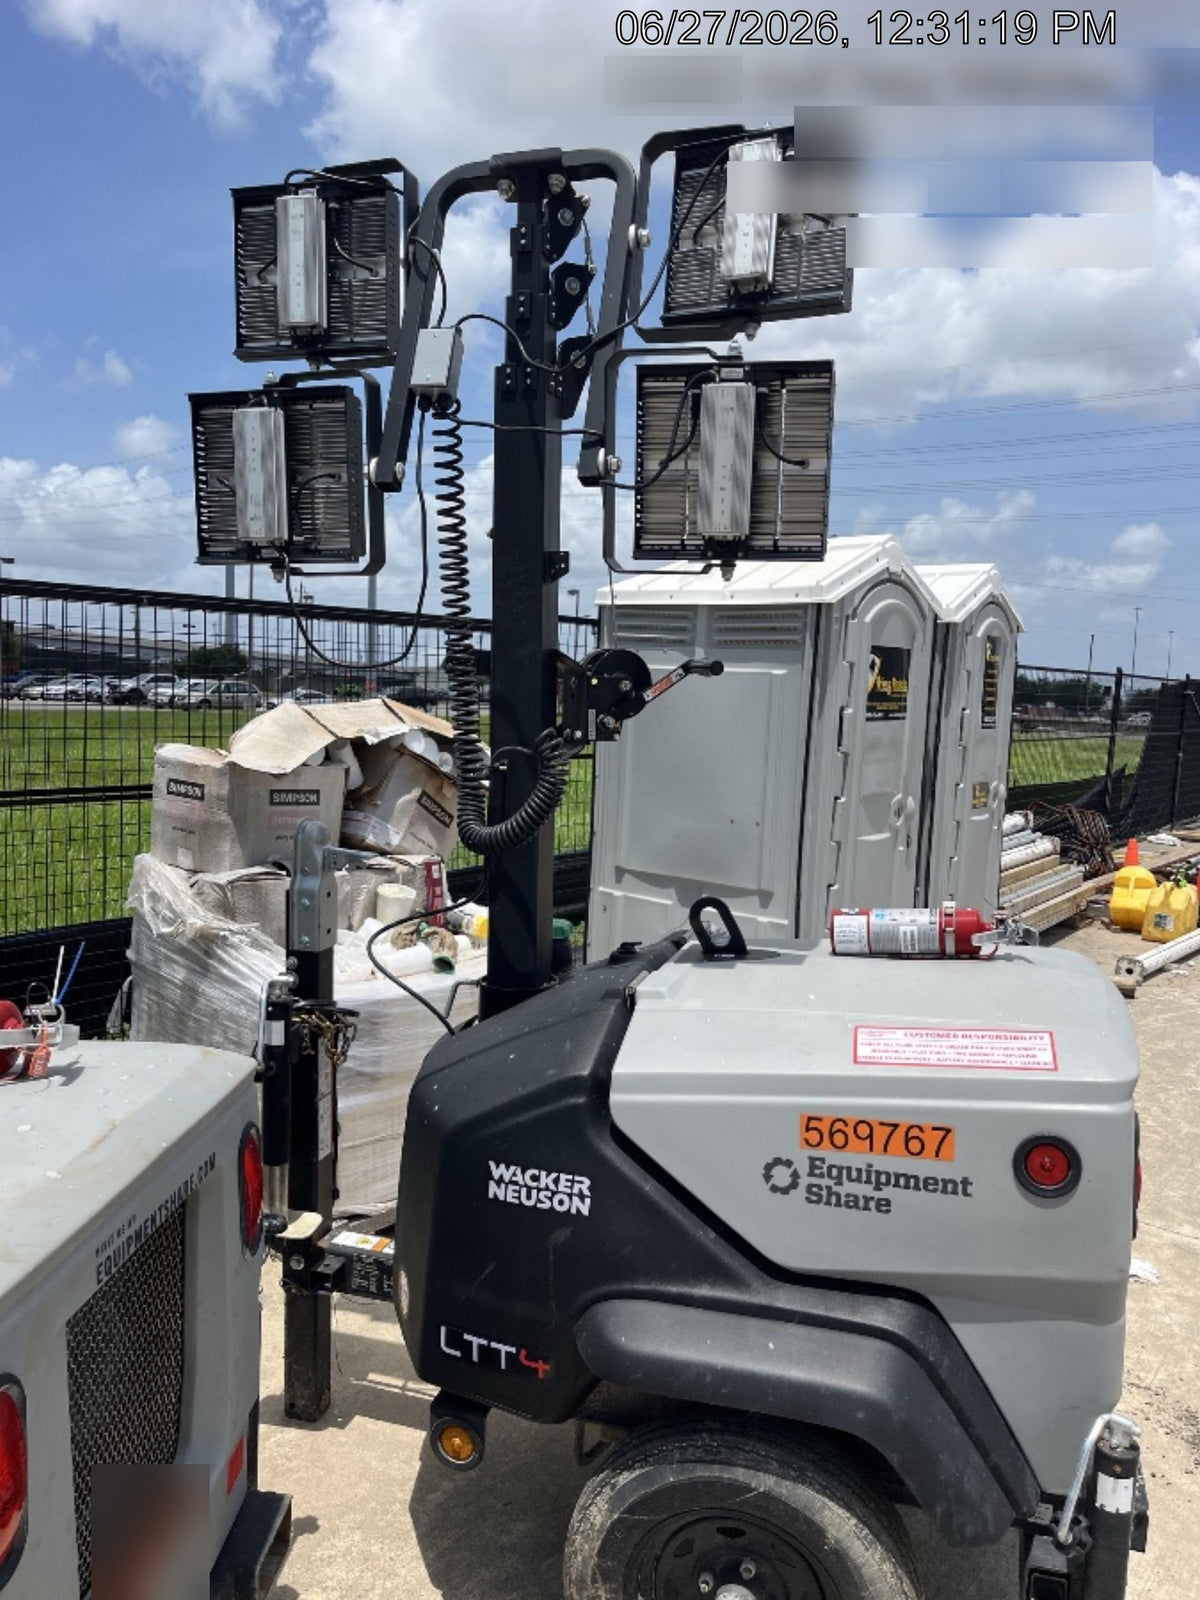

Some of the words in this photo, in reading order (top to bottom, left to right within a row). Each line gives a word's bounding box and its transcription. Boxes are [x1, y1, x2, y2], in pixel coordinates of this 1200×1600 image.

[272, 791, 318, 803] SIMPSON
[903, 1031, 959, 1040] CUSTOMER
[961, 1033, 1045, 1042] RESPONSIBILITY
[803, 1115, 953, 1158] 569767
[487, 1160, 592, 1196] WACKER
[806, 1155, 973, 1198] Equipment
[487, 1180, 592, 1217] NEUSON
[805, 1183, 892, 1215] Share
[440, 1325, 551, 1379] LTT4
